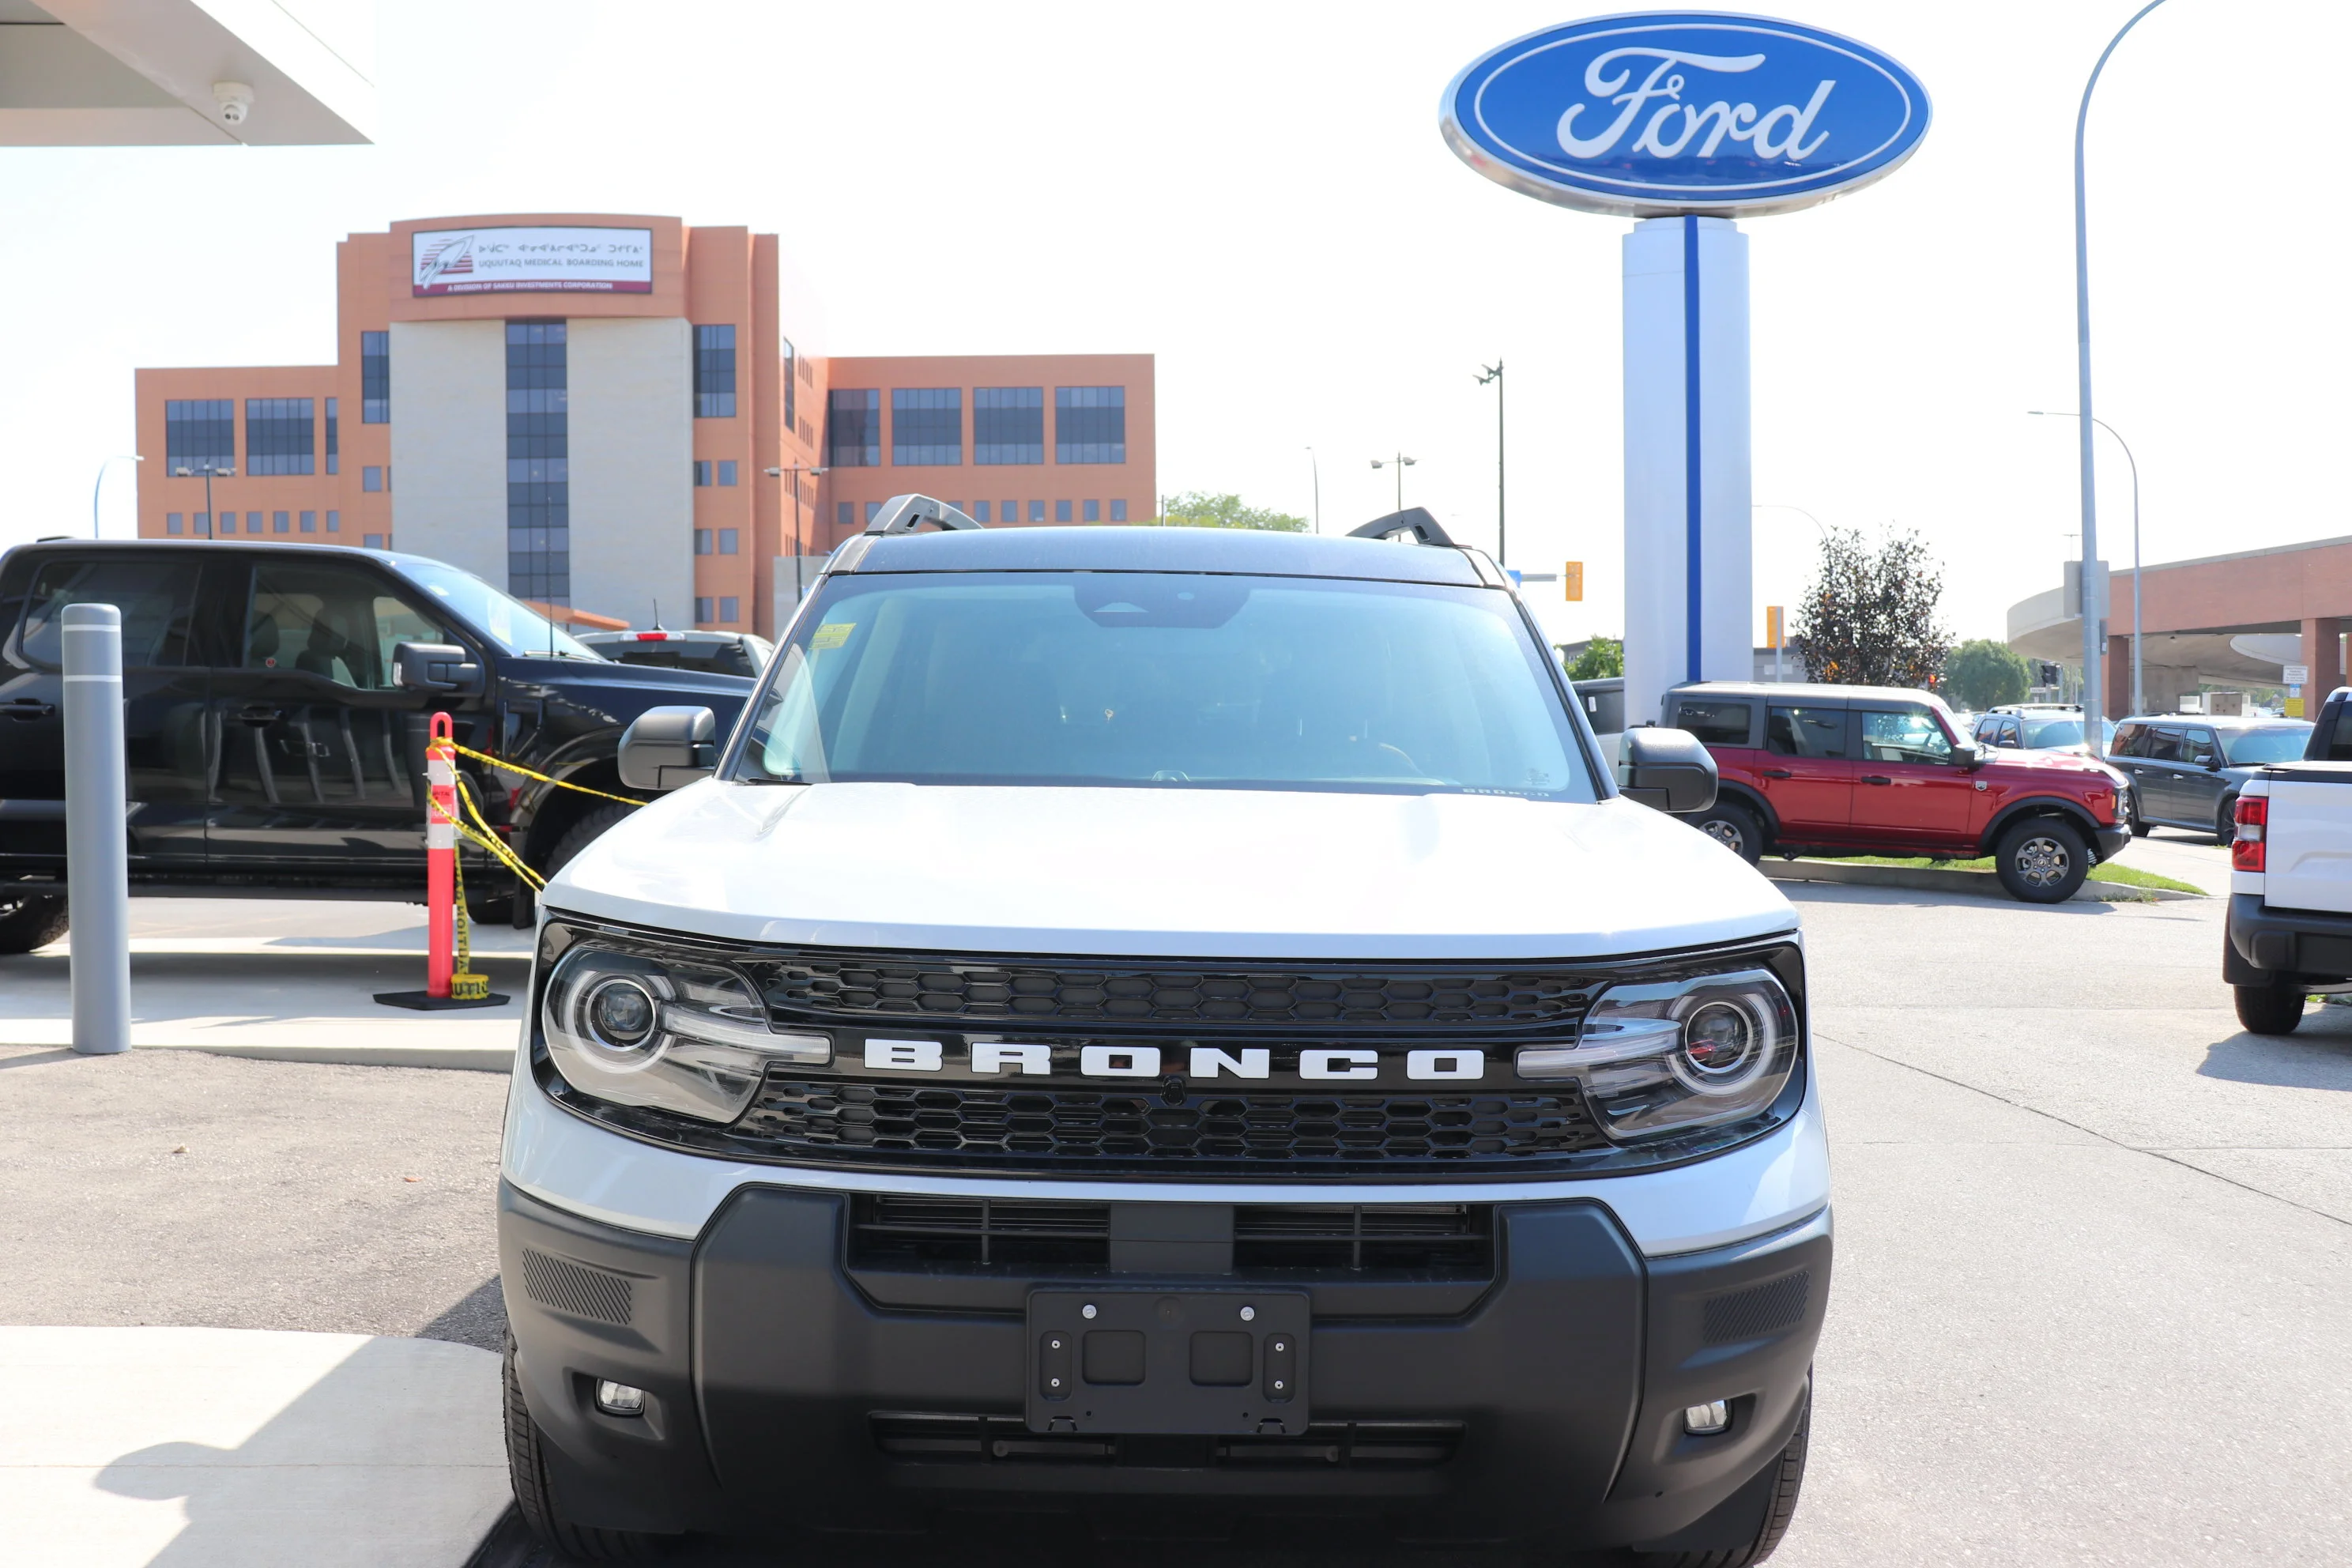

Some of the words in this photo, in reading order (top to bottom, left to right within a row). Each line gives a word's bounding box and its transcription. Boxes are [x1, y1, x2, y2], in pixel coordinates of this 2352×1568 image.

[1556, 47, 1837, 160] Ford
[478, 258, 522, 269] UQUUTAQ
[524, 258, 563, 266] MEDICAL
[566, 258, 614, 267] BOARDING
[454, 283, 482, 292] DIVISION
[563, 281, 613, 289] CORPORATION
[863, 1038, 1486, 1081] BRONCO
